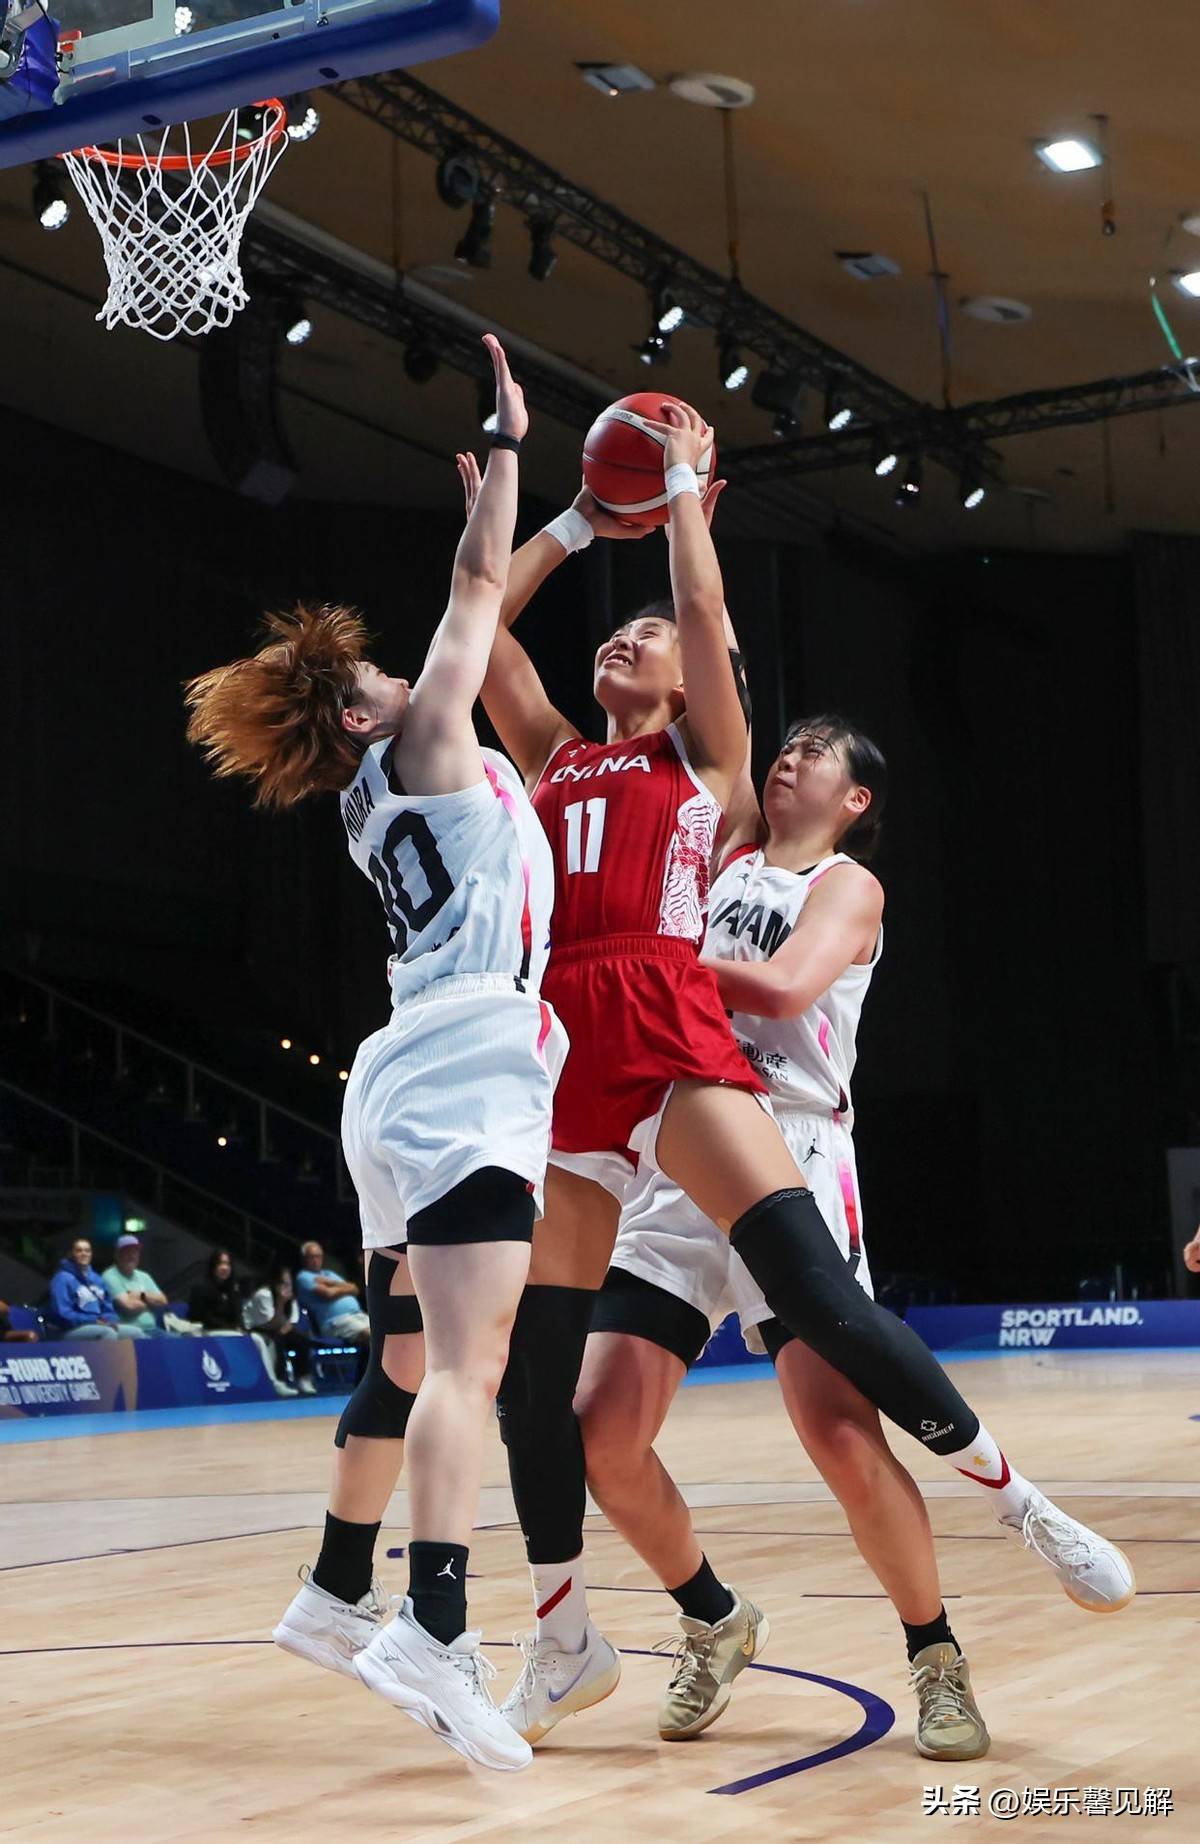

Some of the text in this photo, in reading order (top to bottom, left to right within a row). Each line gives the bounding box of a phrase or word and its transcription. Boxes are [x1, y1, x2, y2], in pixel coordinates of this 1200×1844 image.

[564, 797, 607, 875] 11
[1000, 1306, 1144, 1327] SPORTLAND.
[998, 1327, 1057, 1347] NRW
[49, 1355, 93, 1381] 2025
